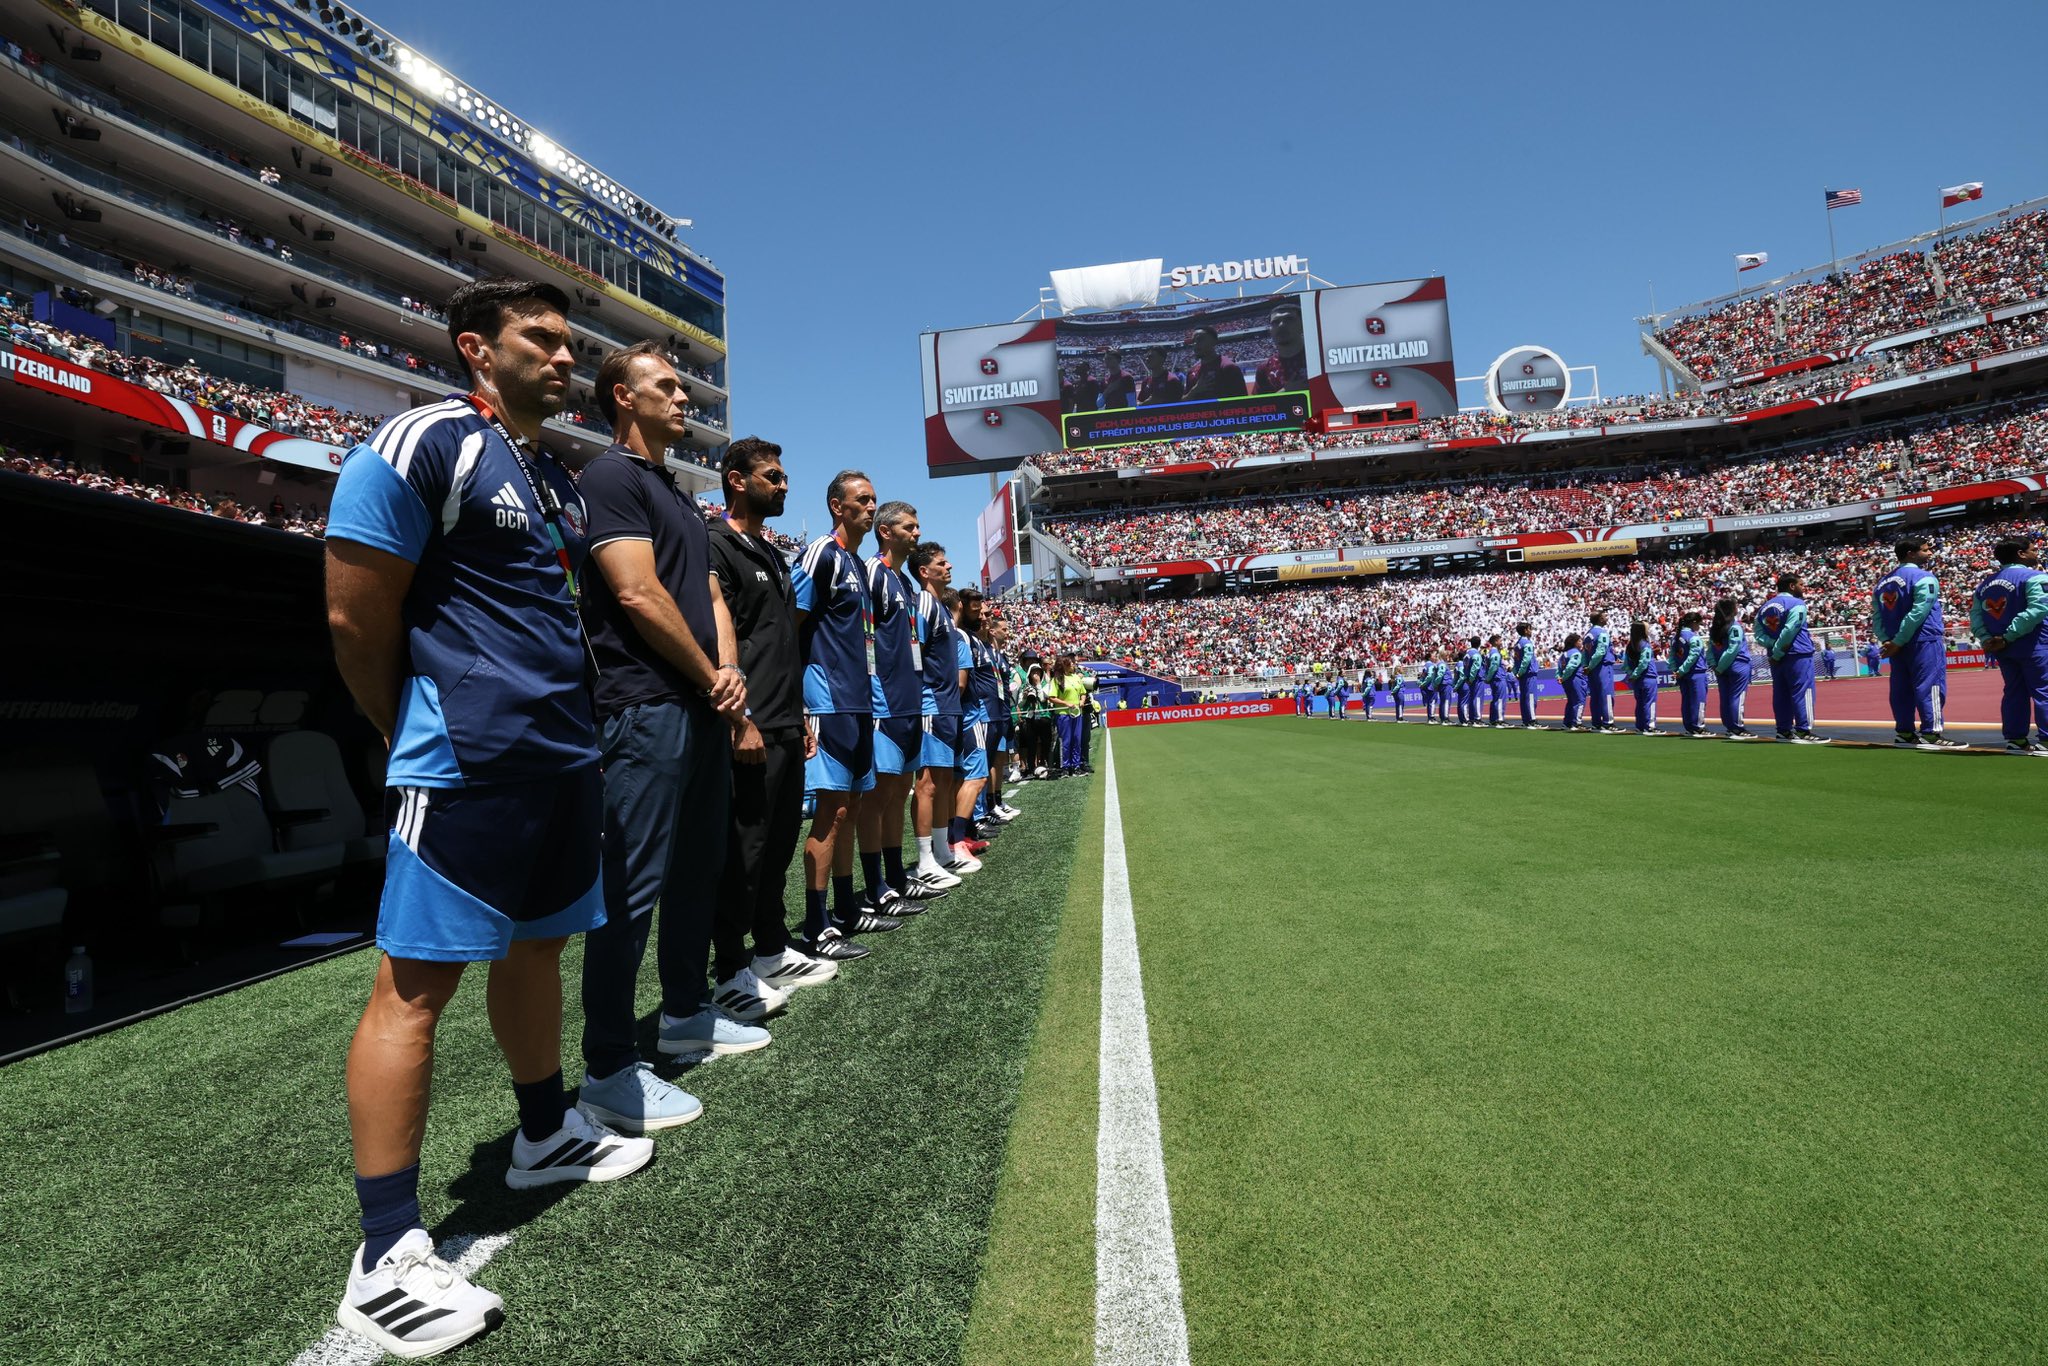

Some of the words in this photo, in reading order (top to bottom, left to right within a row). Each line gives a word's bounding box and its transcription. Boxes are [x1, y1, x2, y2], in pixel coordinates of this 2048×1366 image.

[1171, 254, 1299, 288] STADIUM
[2026, 301, 2047, 311] FIFA
[1328, 340, 1429, 366] SWITZERLAND
[1, 351, 91, 394] ITZERLAND
[944, 379, 1038, 405] SWITZERLAND
[1502, 377, 1557, 391] SWITZERLAND
[1089, 431, 1100, 439] ET
[1102, 427, 1133, 437] PRÉDIT
[1135, 425, 1157, 434] D'UN
[1158, 422, 1181, 432] PLUS
[1183, 420, 1208, 429] BEAU
[1209, 417, 1235, 427] JOUR
[1236, 416, 1248, 425] LE
[1249, 413, 1287, 423] RETOUR
[494, 422, 509, 440] FIFA
[506, 439, 527, 469] WORLD
[524, 468, 534, 486] CUP
[531, 485, 547, 515] 2026
[1880, 495, 1933, 510] SWITZERLAND
[495, 508, 529, 531] OCM
[1734, 519, 1751, 527] FIFA
[1751, 517, 1780, 525] WORLD
[1781, 515, 1797, 523] CUP
[1797, 511, 1831, 522] 2026
[1422, 544, 1448, 552] 2026
[1548, 547, 1592, 555] FRANCISCO
[1946, 656, 1957, 665] HE
[1957, 655, 1976, 664] FIFA
[1136, 711, 1160, 722] FIFA
[1161, 708, 1203, 720] WORLD
[1204, 706, 1228, 717] CUP
[1230, 703, 1270, 715] 2026
